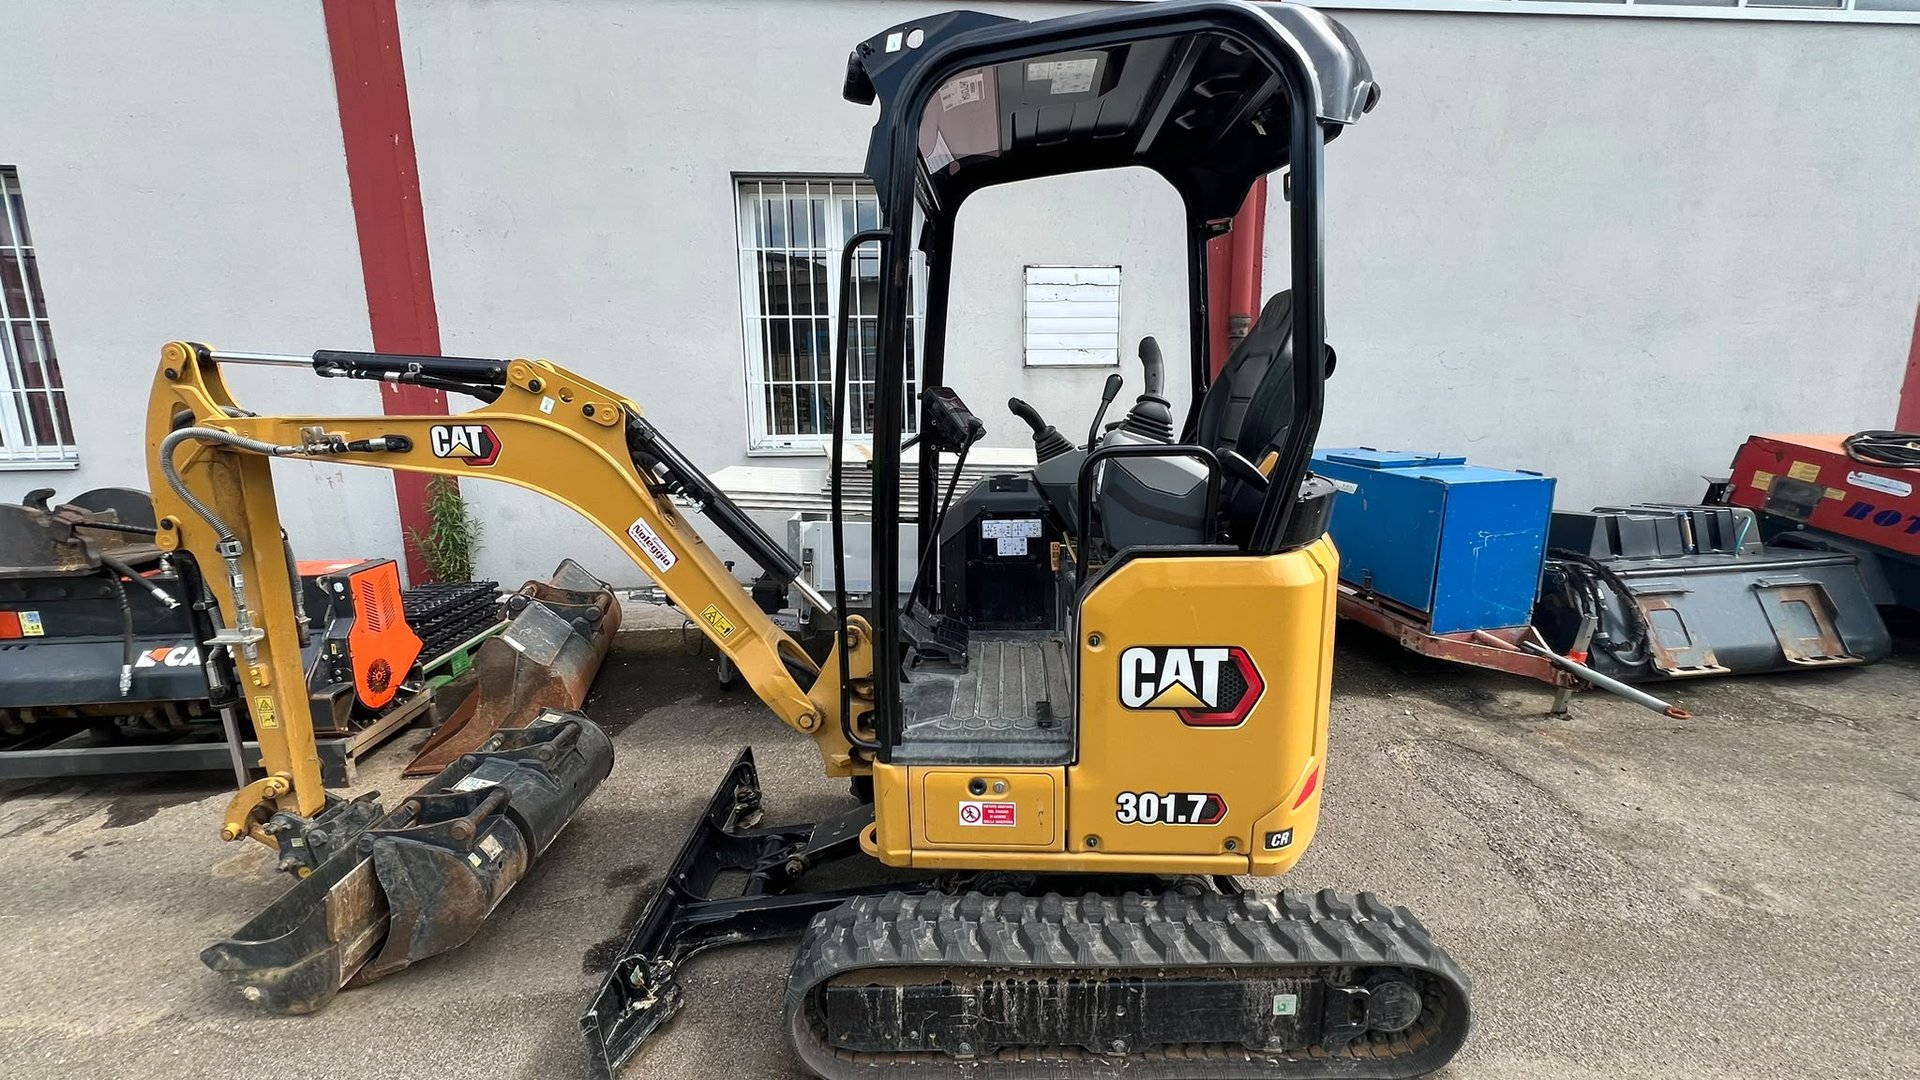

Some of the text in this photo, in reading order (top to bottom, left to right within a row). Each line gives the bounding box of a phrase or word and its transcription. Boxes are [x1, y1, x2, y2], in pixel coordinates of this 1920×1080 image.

[431, 425, 483, 457] CAT
[632, 524, 671, 567] Noleggio
[1121, 647, 1229, 708] CAT
[1117, 792, 1208, 823] 301.7
[1270, 832, 1291, 848] CR
